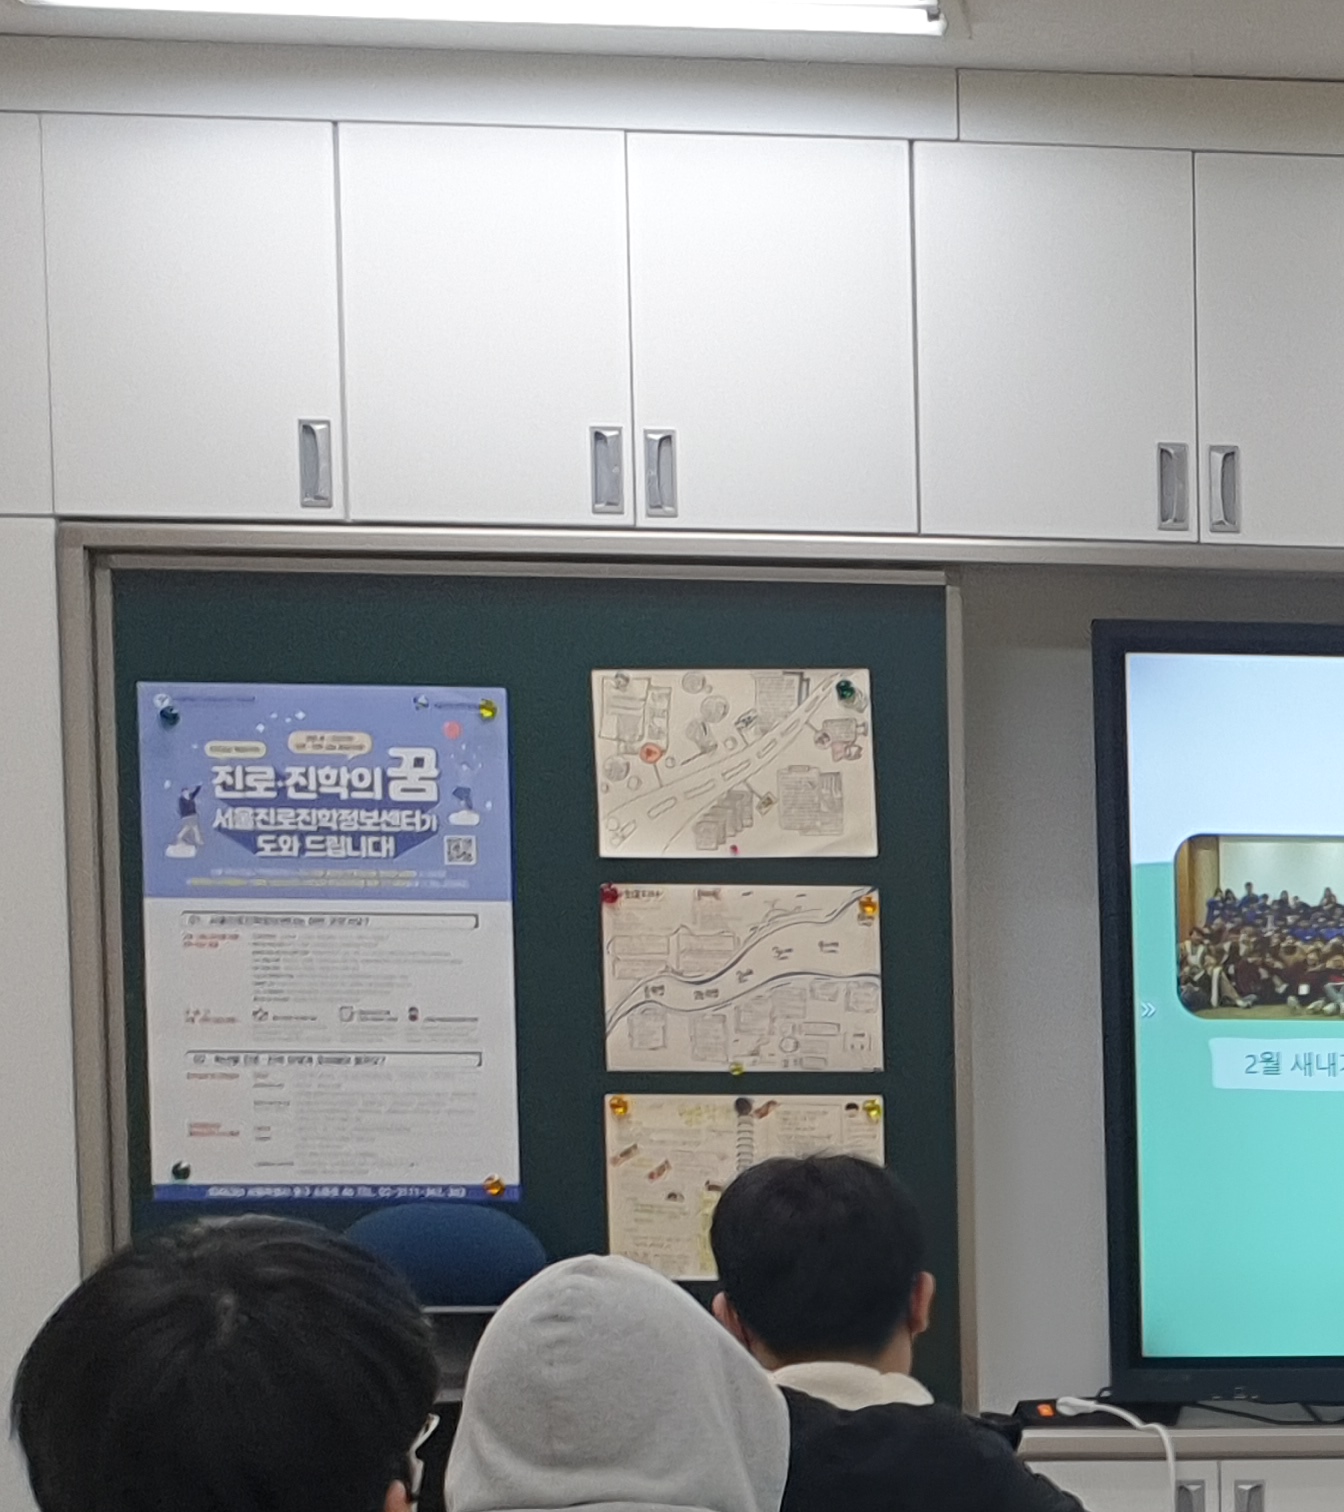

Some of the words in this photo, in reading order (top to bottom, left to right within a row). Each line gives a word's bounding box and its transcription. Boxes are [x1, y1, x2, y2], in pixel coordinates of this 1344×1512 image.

[386, 746, 441, 802] 꿈
[212, 807, 440, 834] 서울진로진학정보센터가
[256, 834, 301, 858] 도와
[304, 834, 396, 859] 드립니다
[1244, 1052, 1283, 1078] 2월
